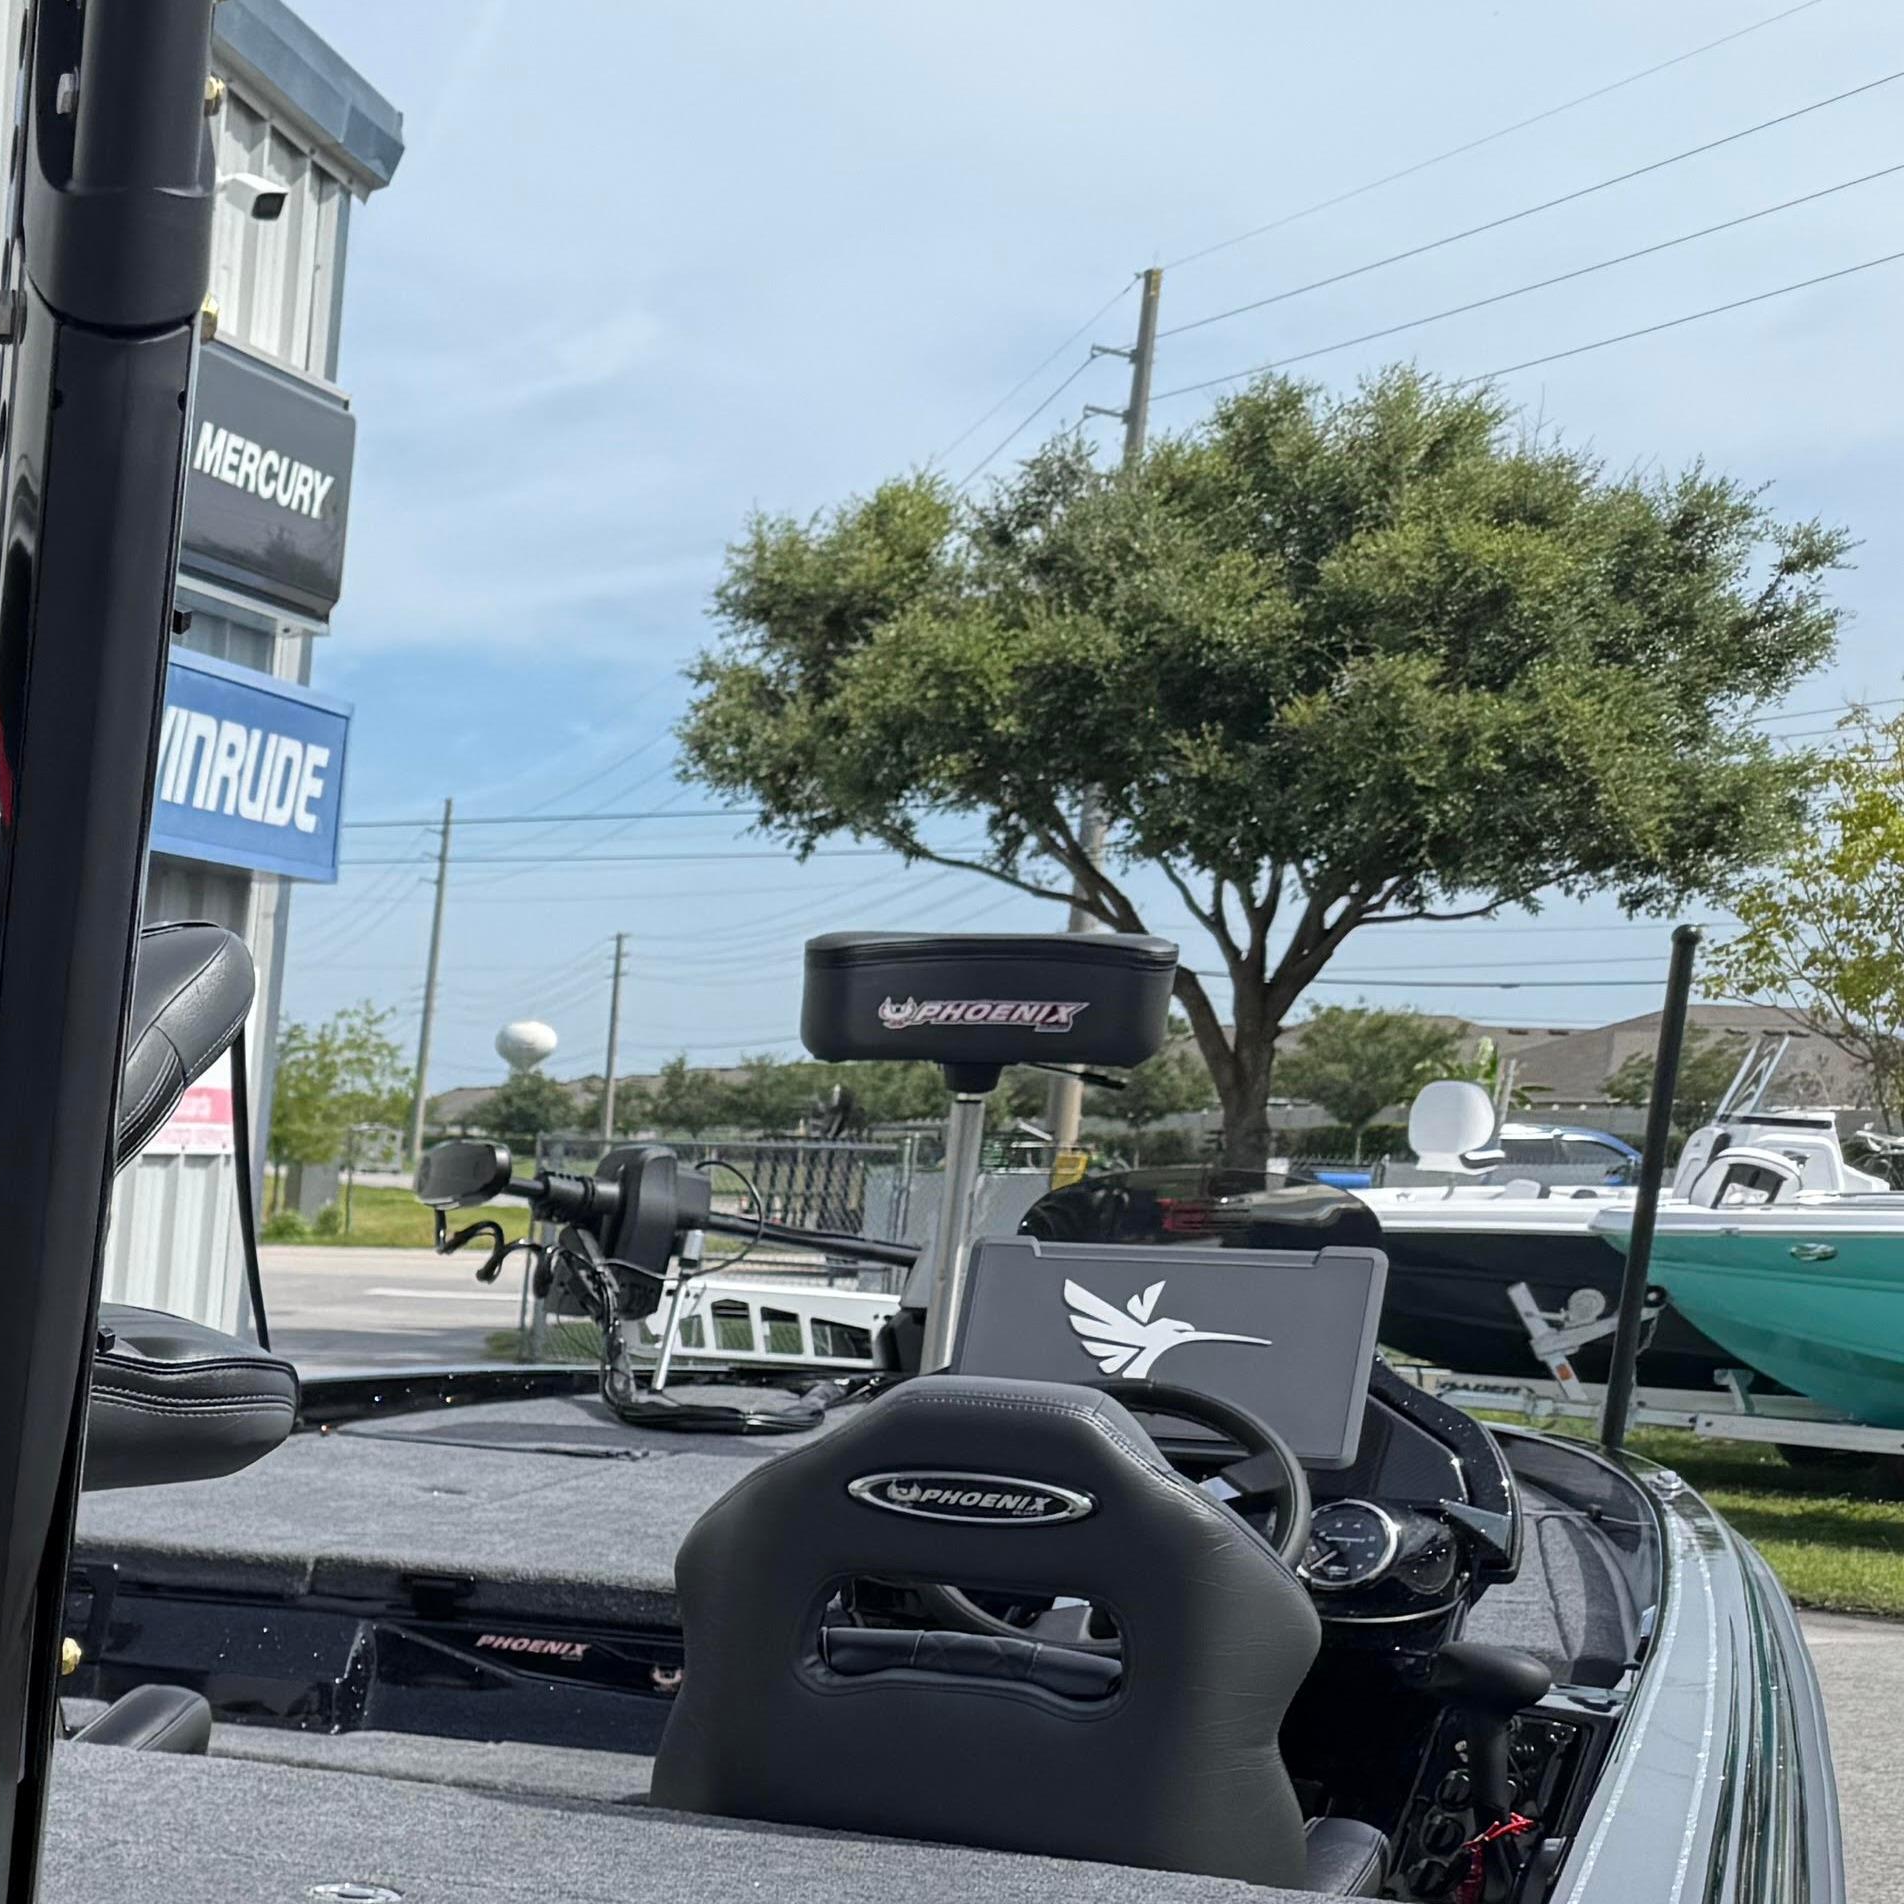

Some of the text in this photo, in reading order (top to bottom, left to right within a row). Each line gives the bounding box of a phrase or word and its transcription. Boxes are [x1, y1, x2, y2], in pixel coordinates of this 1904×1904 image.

[192, 422, 334, 519] MERCURY
[914, 1001, 1084, 1024] PHOENIX
[919, 1489, 1053, 1511] PHOENIX
[475, 1634, 592, 1656] PHOENIX
